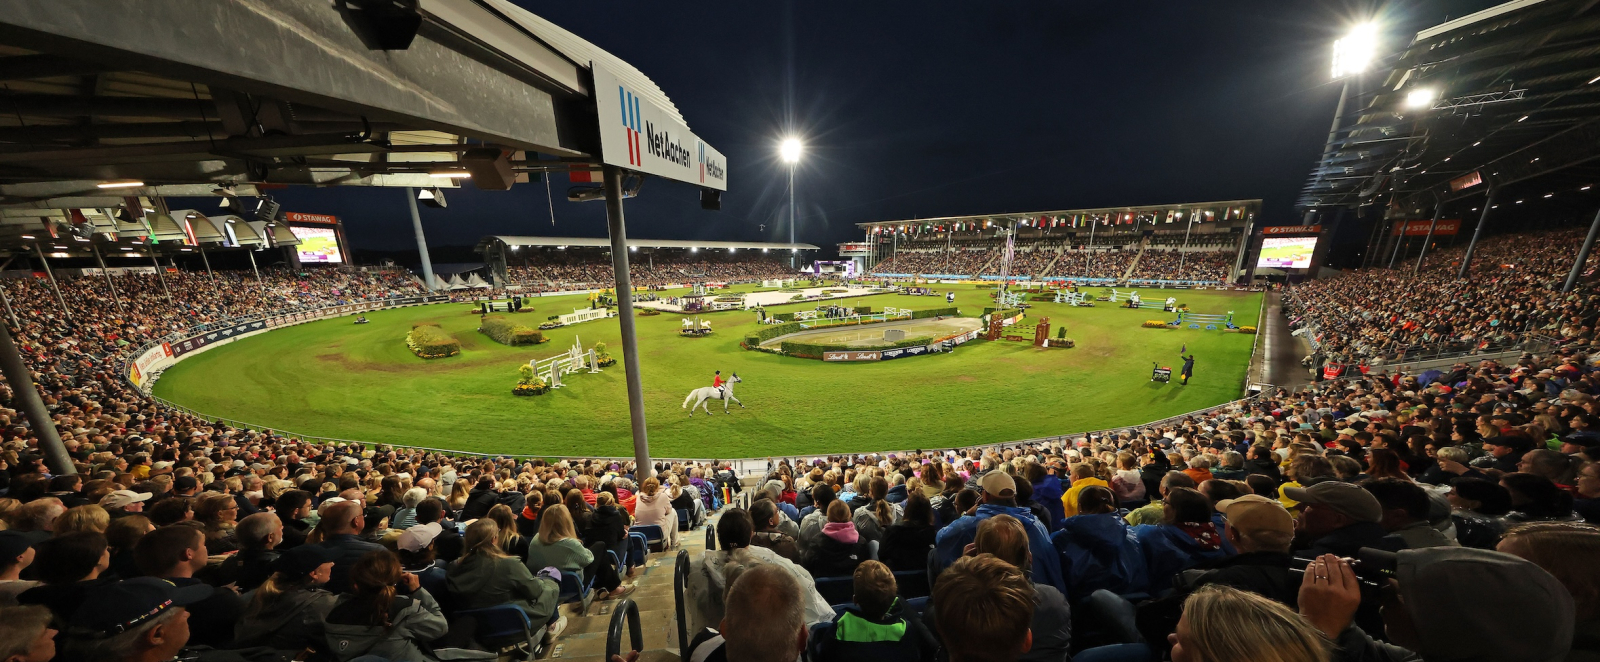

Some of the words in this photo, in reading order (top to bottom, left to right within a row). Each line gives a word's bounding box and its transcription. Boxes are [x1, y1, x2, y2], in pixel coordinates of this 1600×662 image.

[645, 120, 691, 169] NetAachen
[705, 156, 724, 181] NetAachen
[302, 214, 331, 223] STAWAG
[827, 352, 843, 360] Lindt
[856, 352, 872, 360] Lindt
